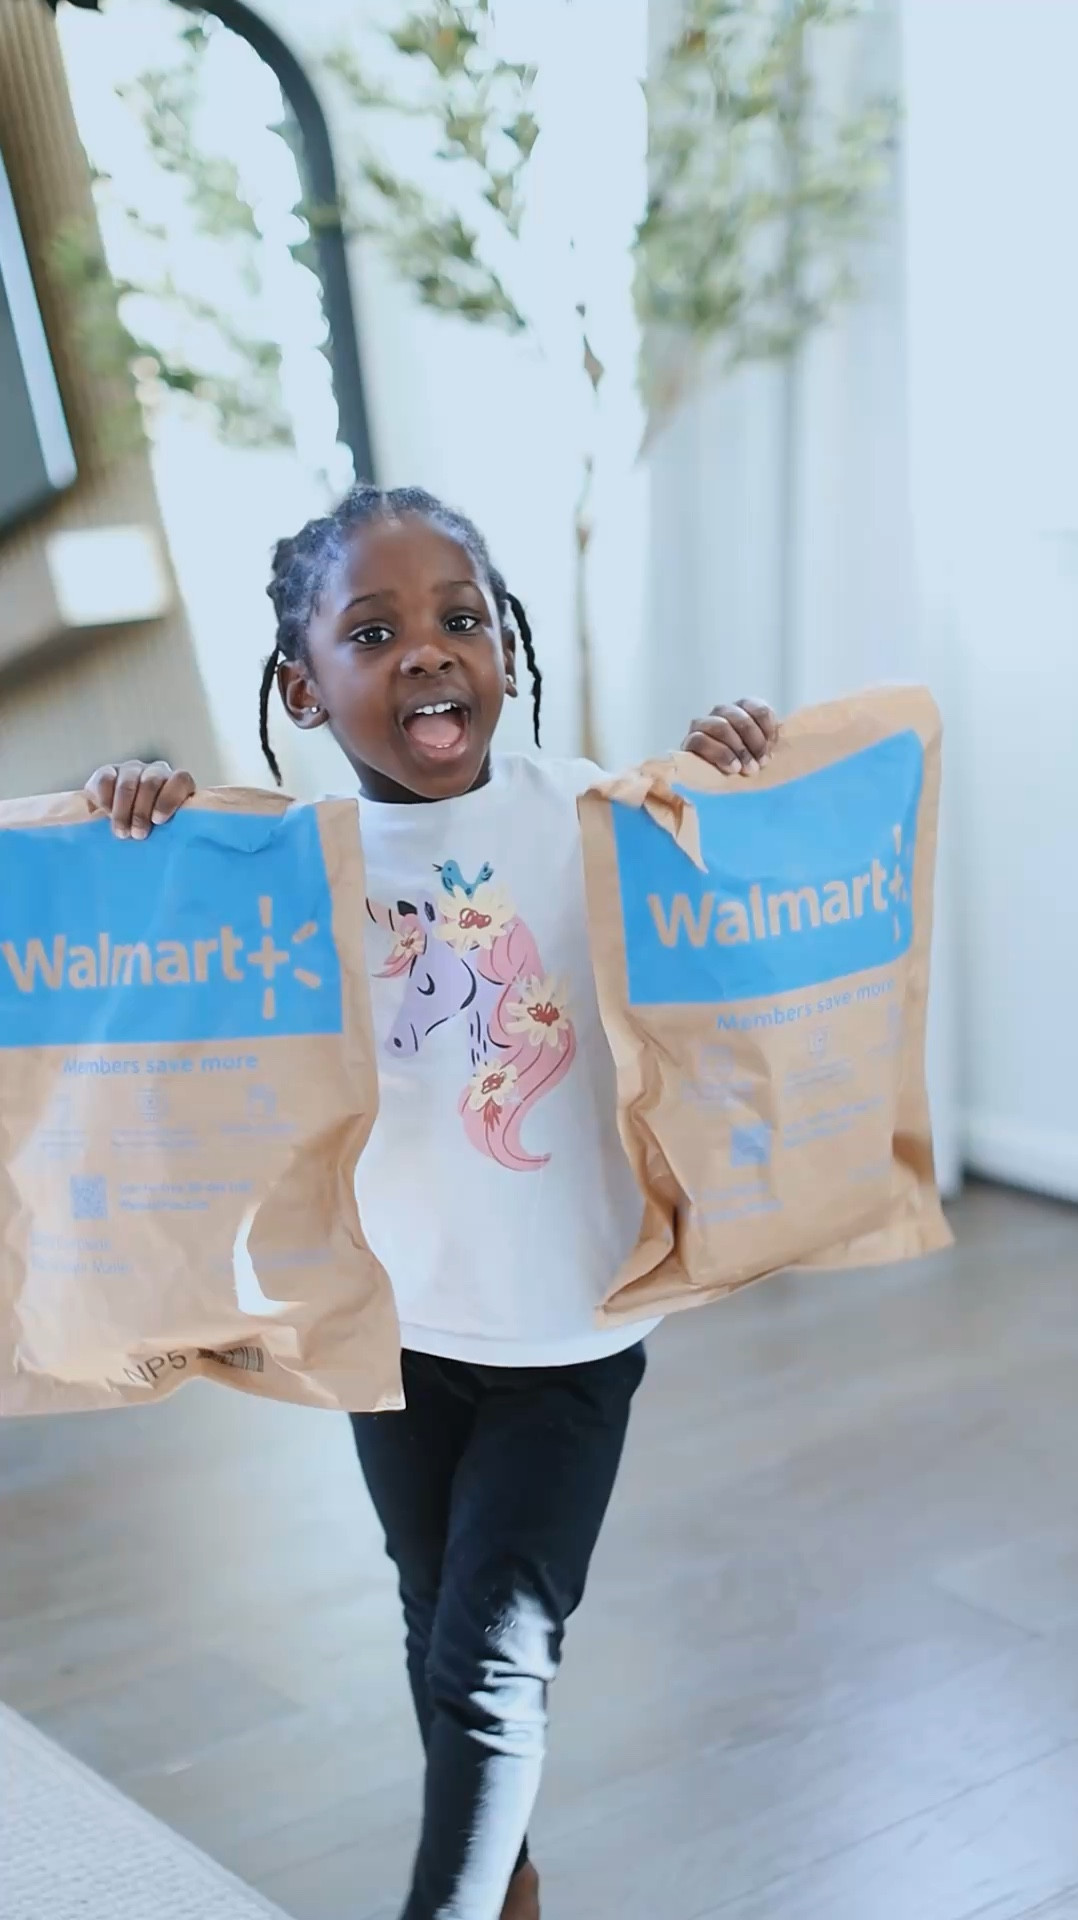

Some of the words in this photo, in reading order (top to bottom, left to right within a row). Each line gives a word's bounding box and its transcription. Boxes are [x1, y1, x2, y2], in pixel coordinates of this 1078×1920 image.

[716, 1003, 812, 1032] Members
[816, 991, 851, 1013] save
[63, 1055, 140, 1076] Members
[145, 1057, 193, 1074] save
[200, 1054, 259, 1074] more
